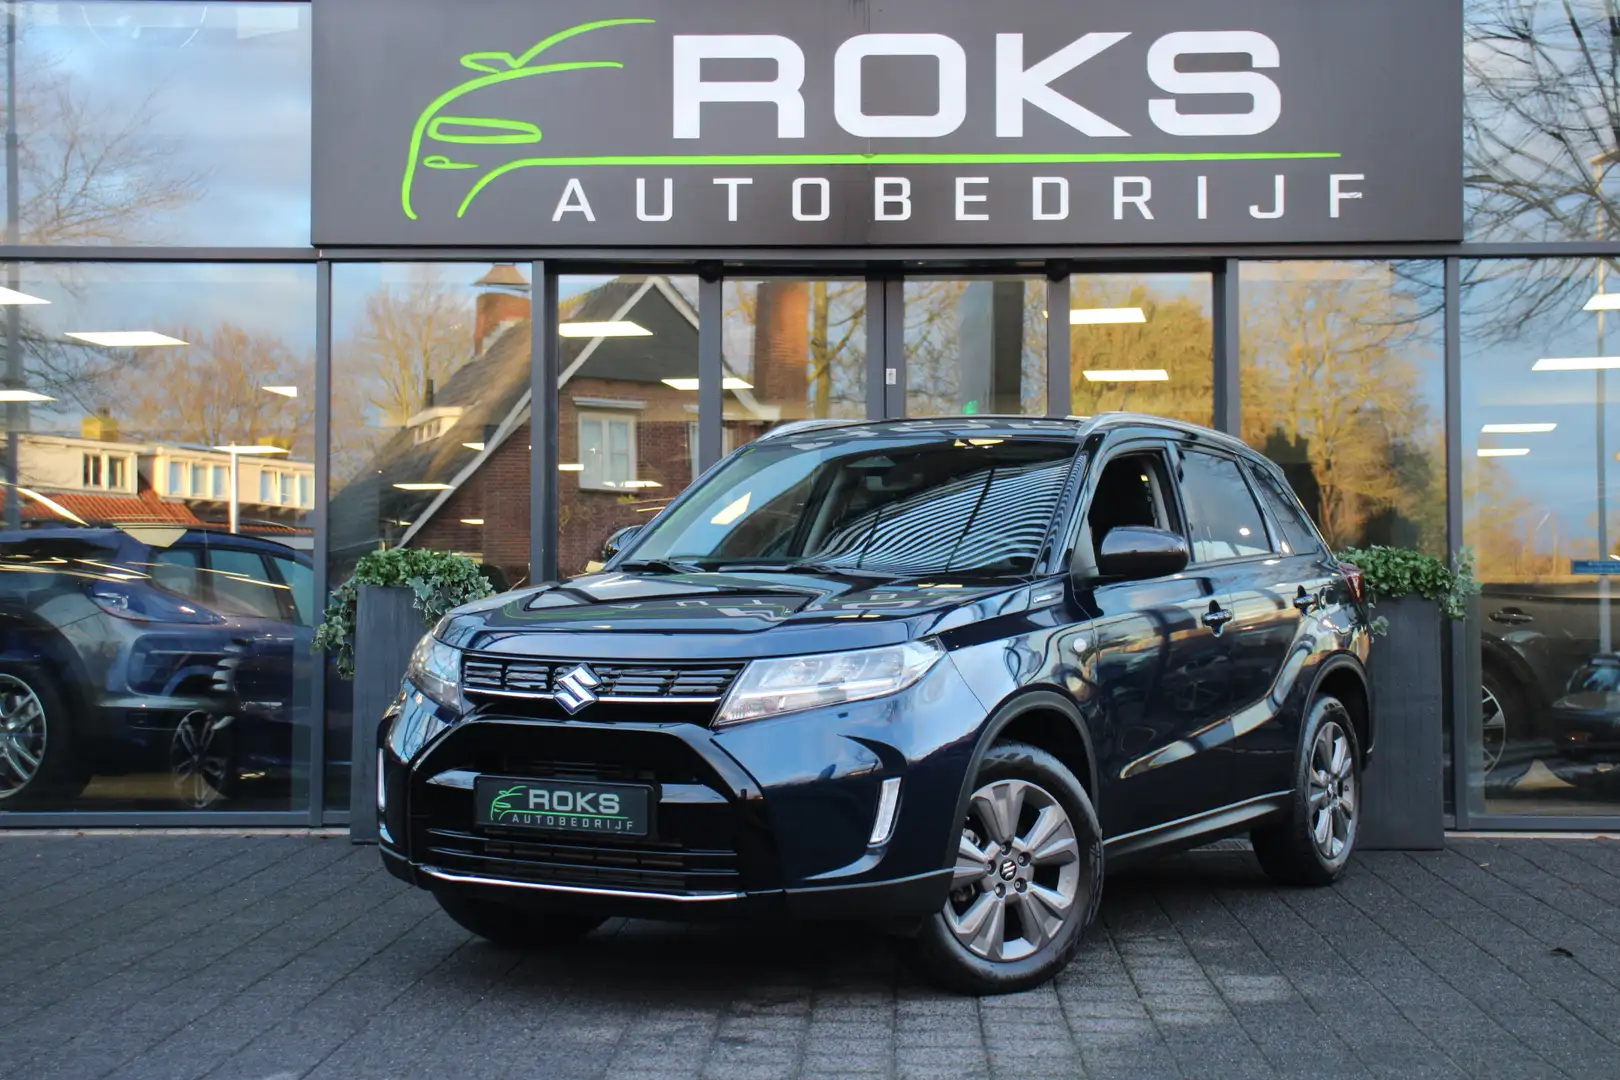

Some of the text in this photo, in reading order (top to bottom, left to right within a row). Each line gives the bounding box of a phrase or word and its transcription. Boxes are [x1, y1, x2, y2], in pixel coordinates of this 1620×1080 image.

[673, 31, 1282, 138] ROKS
[551, 174, 1364, 222] AUTOBEDRIJF
[529, 789, 620, 814] ROKS
[512, 814, 633, 831] AUTOBEDRIJF
